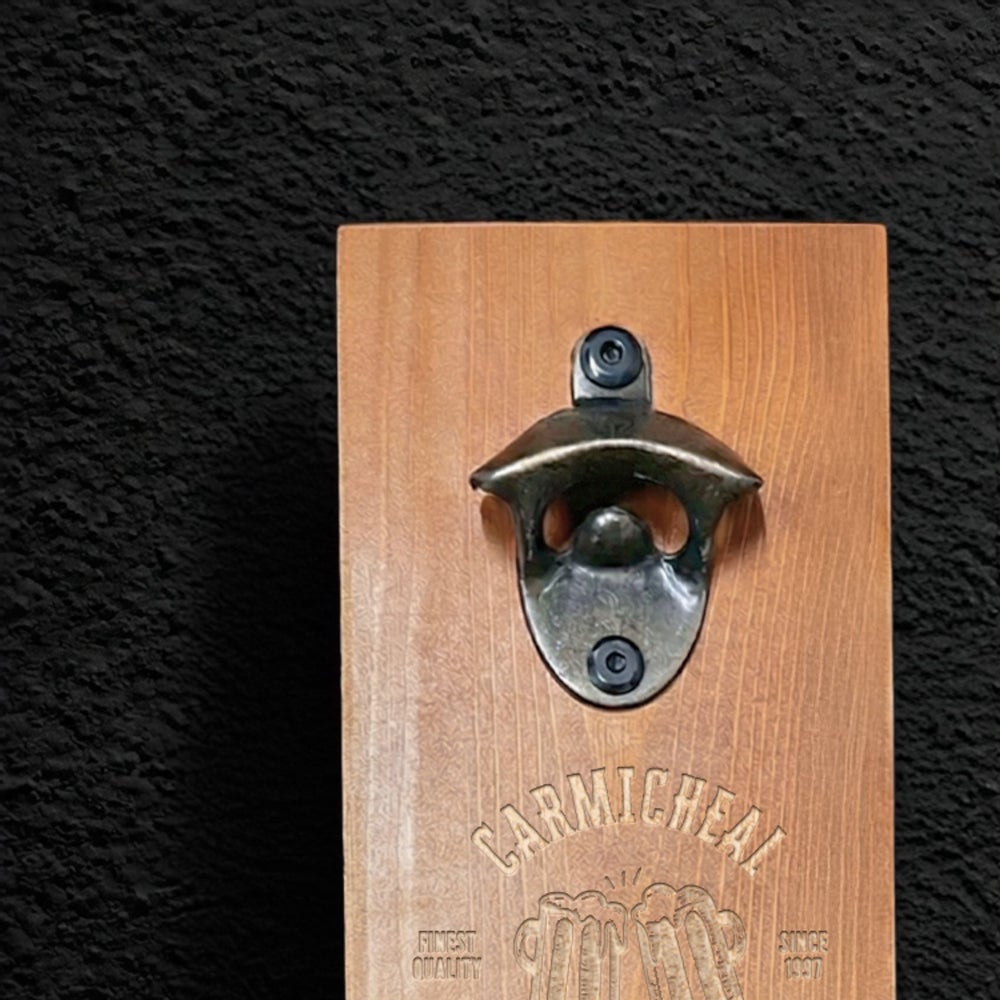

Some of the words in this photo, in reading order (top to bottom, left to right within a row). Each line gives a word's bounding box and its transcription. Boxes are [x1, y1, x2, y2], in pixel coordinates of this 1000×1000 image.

[470, 766, 787, 877] CARMICHEAL
[418, 930, 477, 953] FINEST
[779, 930, 828, 953] SINCE
[412, 956, 482, 980] QUALITY
